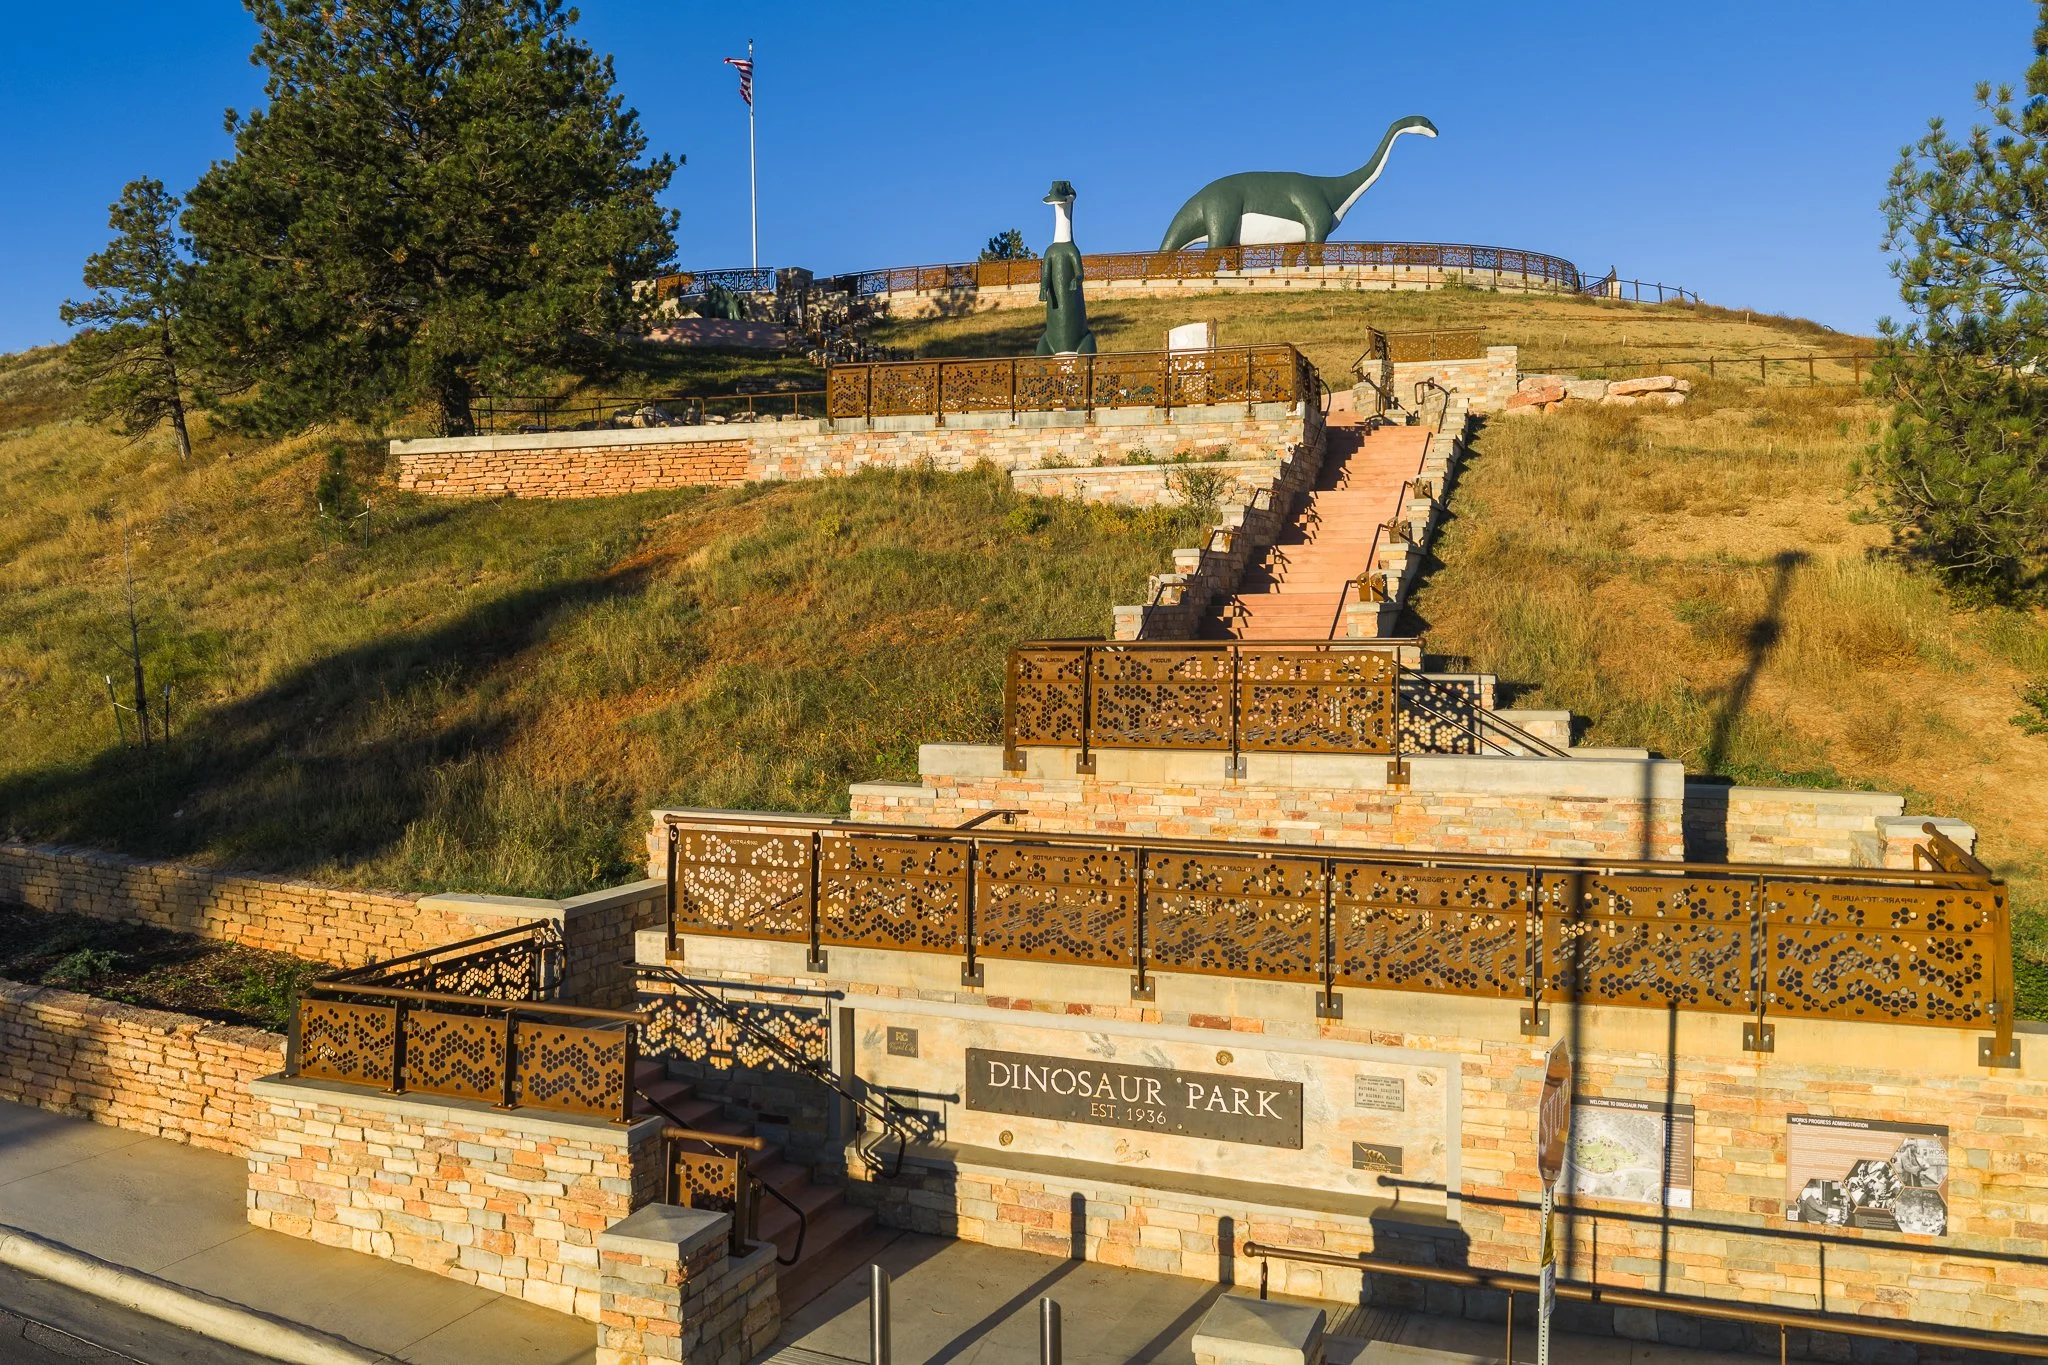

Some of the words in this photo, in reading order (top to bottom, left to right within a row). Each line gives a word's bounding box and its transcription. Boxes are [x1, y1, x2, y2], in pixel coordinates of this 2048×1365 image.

[895, 1031, 909, 1042] RC
[987, 1060, 1167, 1106] DINOSAUR
[1186, 1082, 1283, 1120] PARK
[1616, 1101, 1638, 1109] DINOSAUR
[1090, 1102, 1121, 1121] EST.
[1127, 1107, 1167, 1126] 1936
[1542, 1079, 1569, 1154] STOP
[1808, 1118, 1832, 1126] PROGRESS
[1832, 1120, 1869, 1129] ADMINISTRATION
